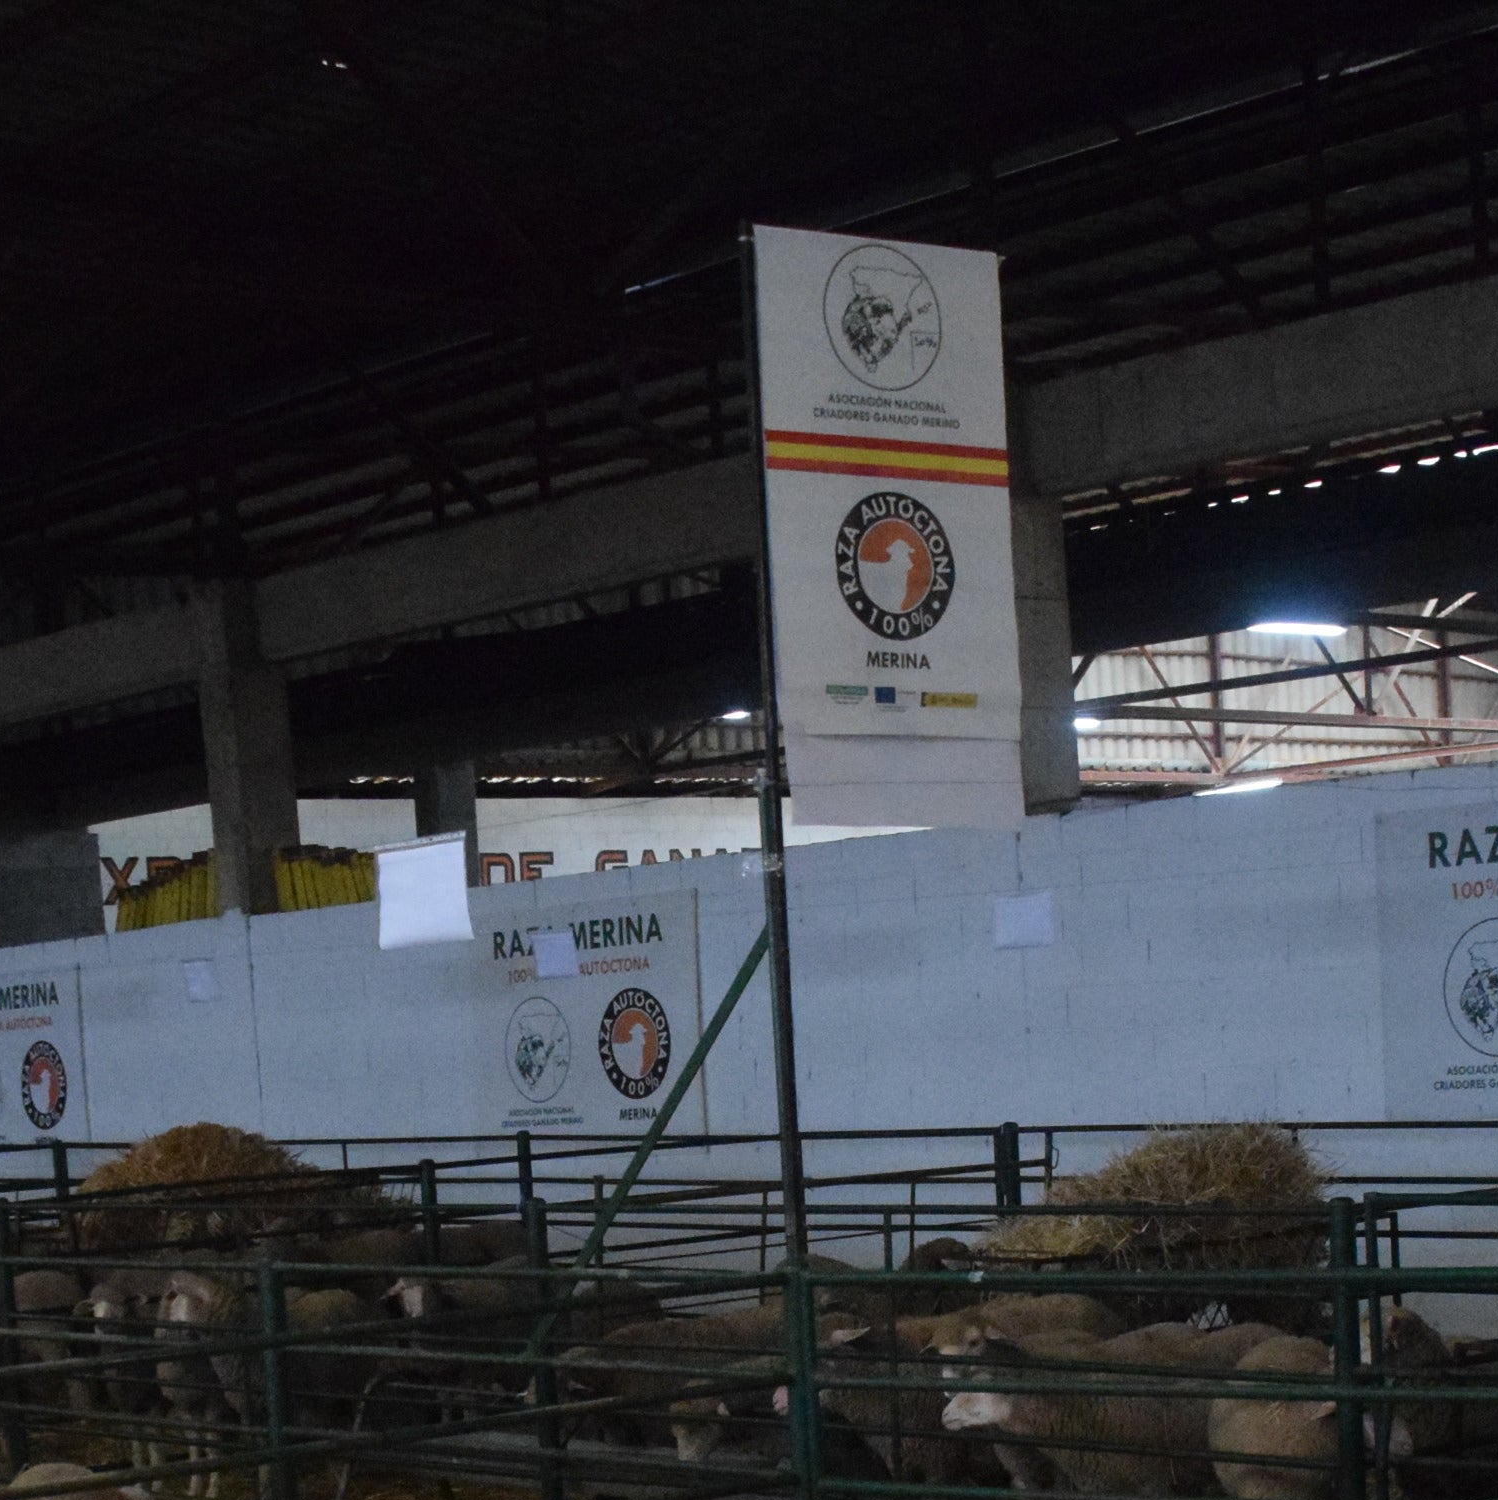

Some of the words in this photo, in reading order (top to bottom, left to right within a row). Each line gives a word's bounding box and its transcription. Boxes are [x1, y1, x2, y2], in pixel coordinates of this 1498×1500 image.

[894, 399, 947, 413] NACIONAL
[813, 407, 870, 422] CRIADORES
[873, 412, 919, 426] GANADO
[921, 416, 961, 430] MERINO
[837, 525, 861, 597] RAZA
[860, 495, 951, 593] AUTÓCTONA
[868, 609, 934, 637] 100%
[866, 651, 931, 670] MERINA
[569, 913, 663, 951] MERINA
[578, 954, 650, 977] AUTÓCTONA
[599, 1018, 615, 1071] RAZA
[612, 991, 669, 1060] AUTÓCTONA
[620, 1072, 660, 1096] 100%
[1433, 1078, 1487, 1091] CRIADORES
[619, 1107, 658, 1121] MERINA
